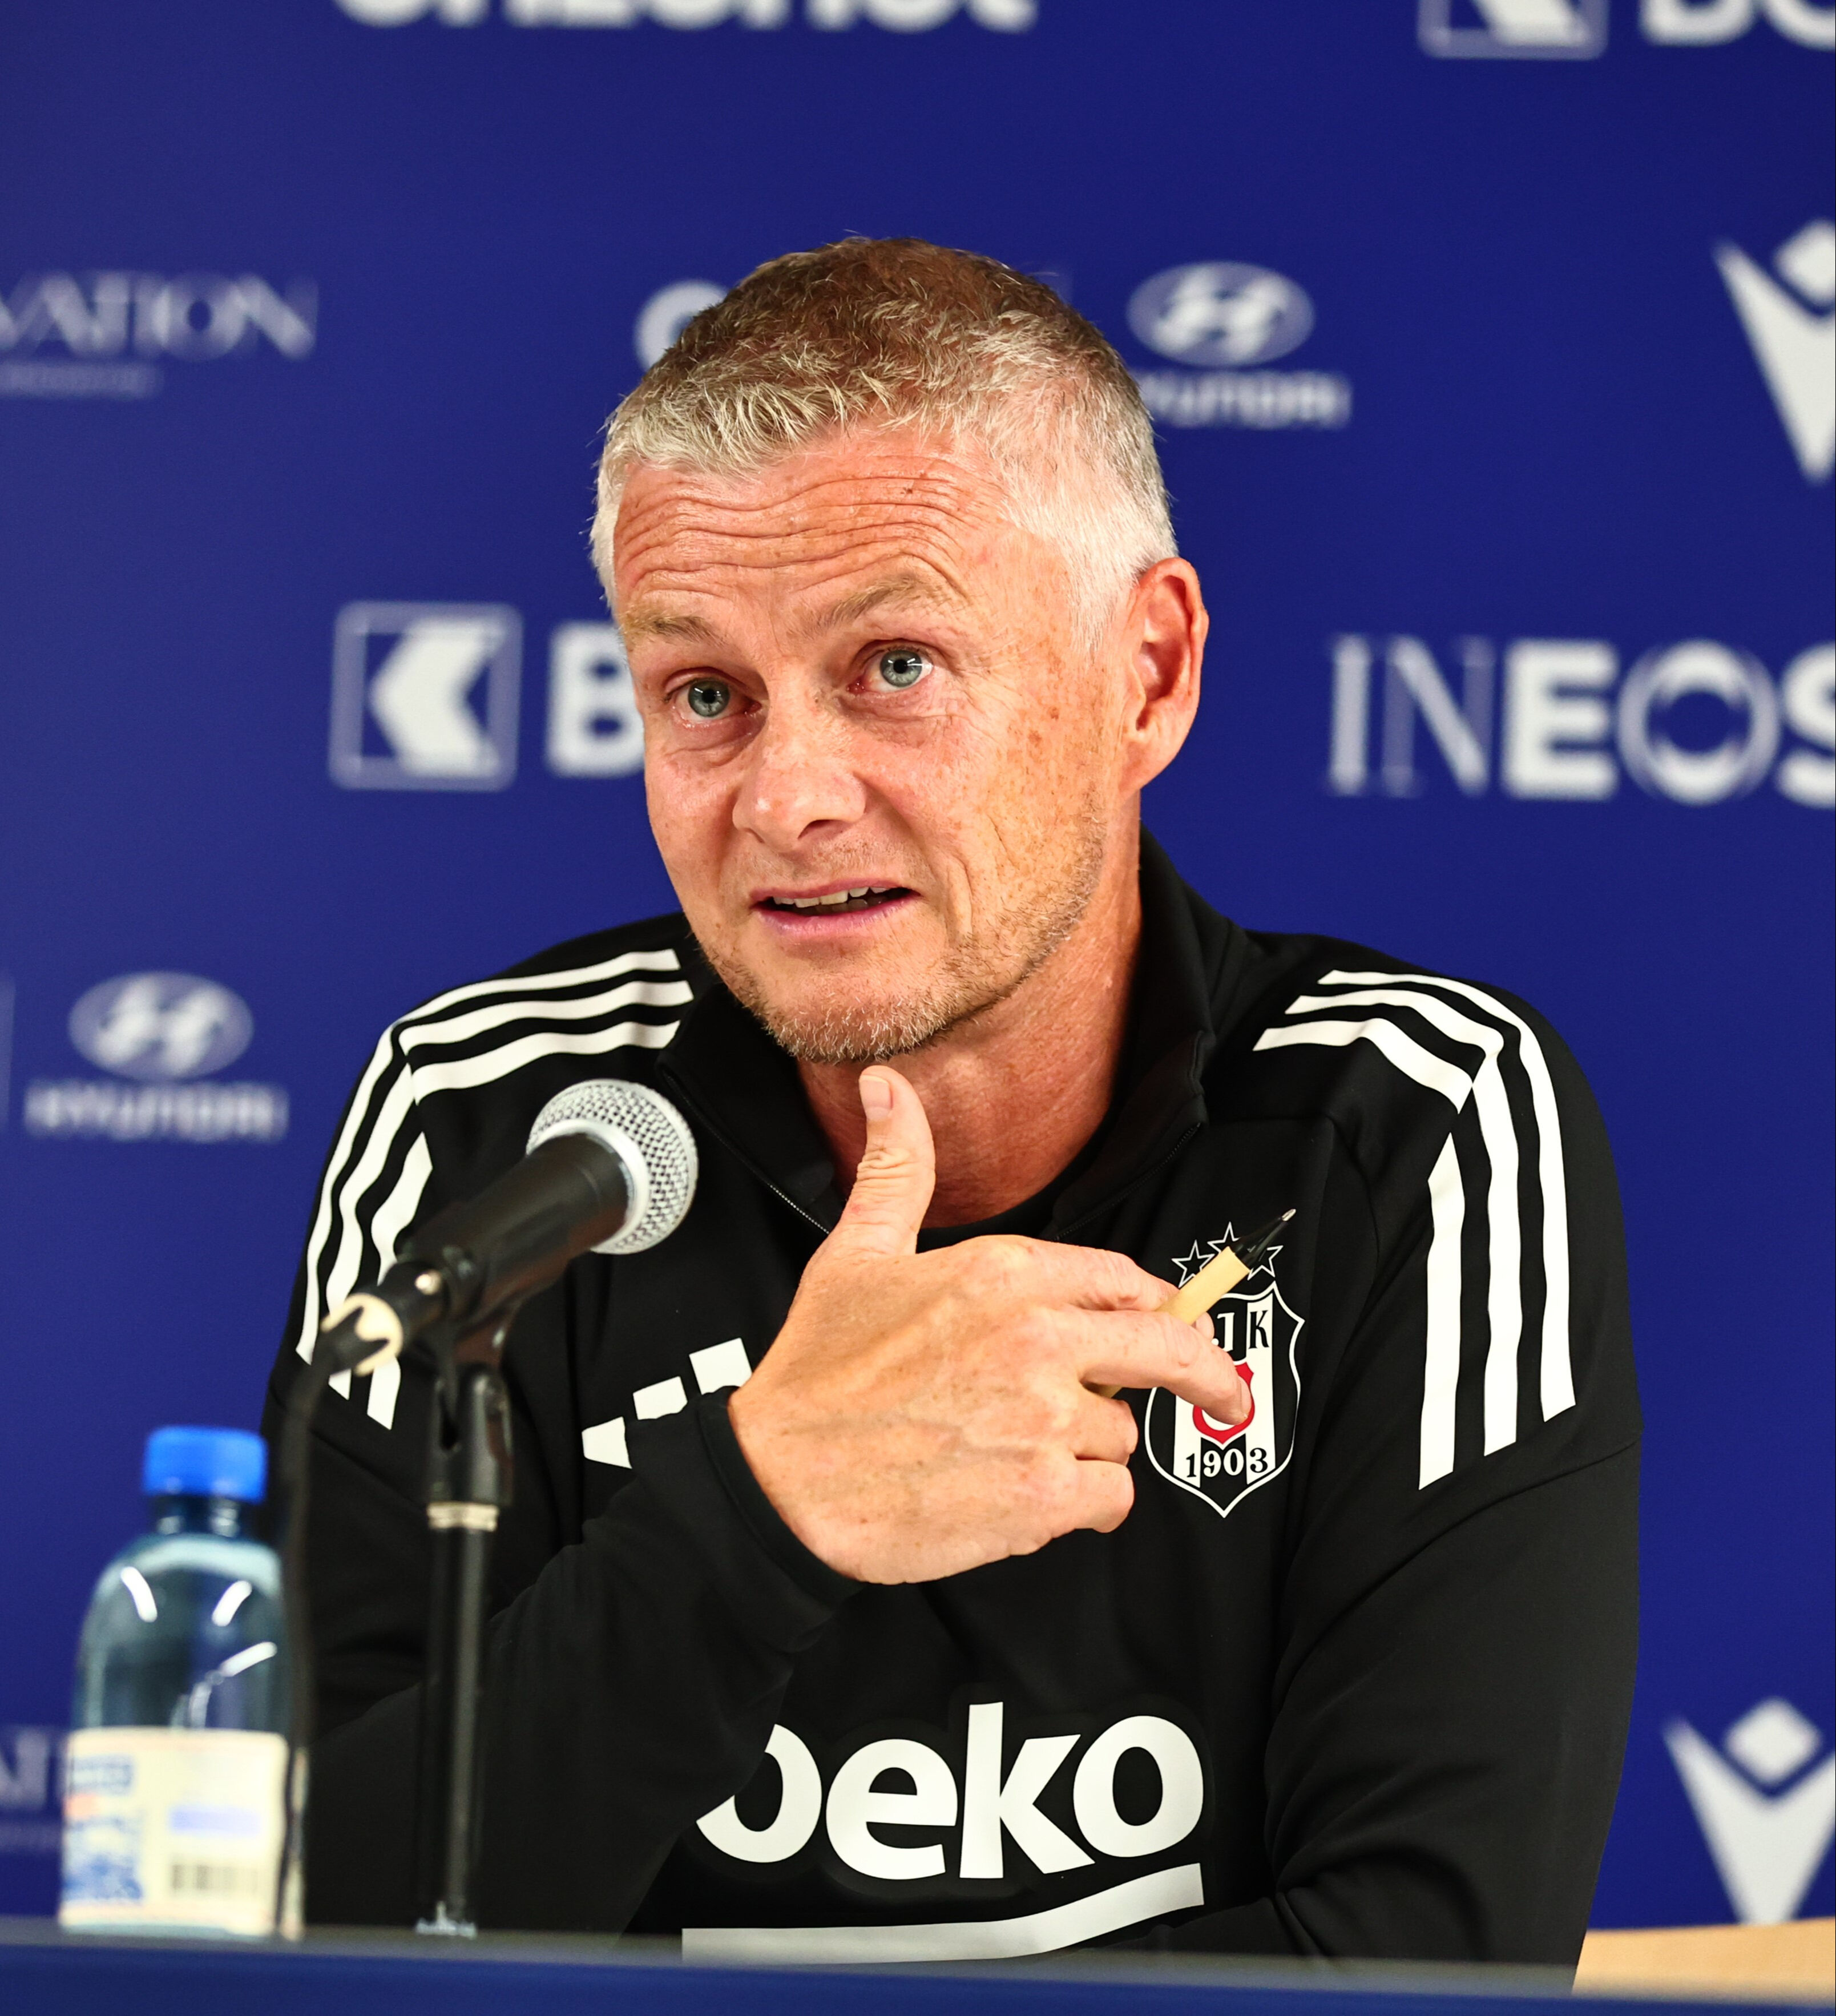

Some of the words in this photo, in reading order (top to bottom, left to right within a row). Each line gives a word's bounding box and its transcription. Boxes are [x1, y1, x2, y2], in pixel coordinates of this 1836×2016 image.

[1129, 371, 1353, 429] YUNDAI
[1329, 634, 1834, 808] INEOS
[1186, 1448, 1268, 1478] 1903
